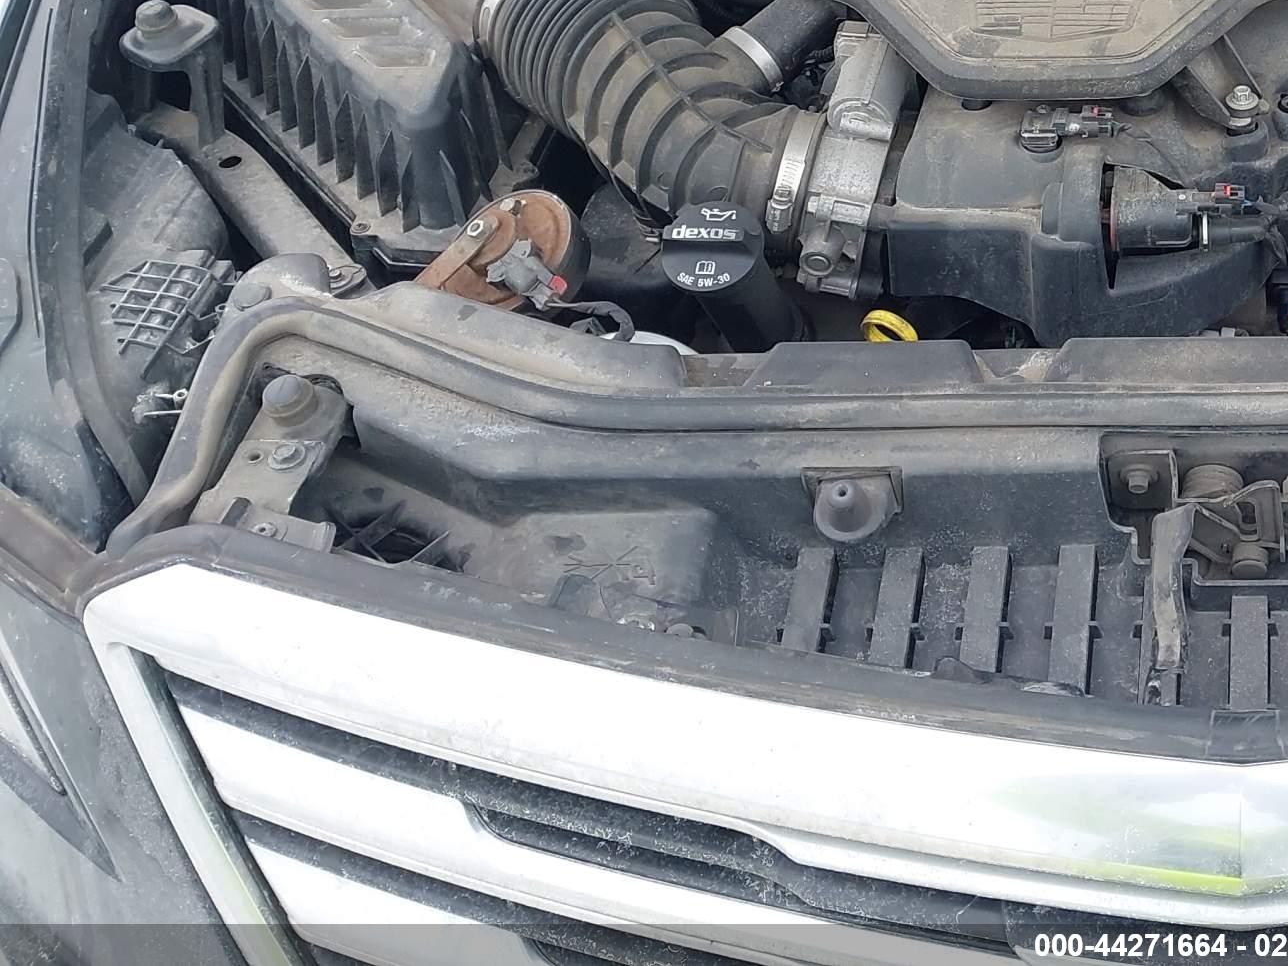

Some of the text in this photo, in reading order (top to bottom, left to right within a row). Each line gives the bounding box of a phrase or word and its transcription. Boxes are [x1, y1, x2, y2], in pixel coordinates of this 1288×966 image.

[671, 224, 739, 240] dexos
[676, 271, 731, 288] SAE 5W-30
